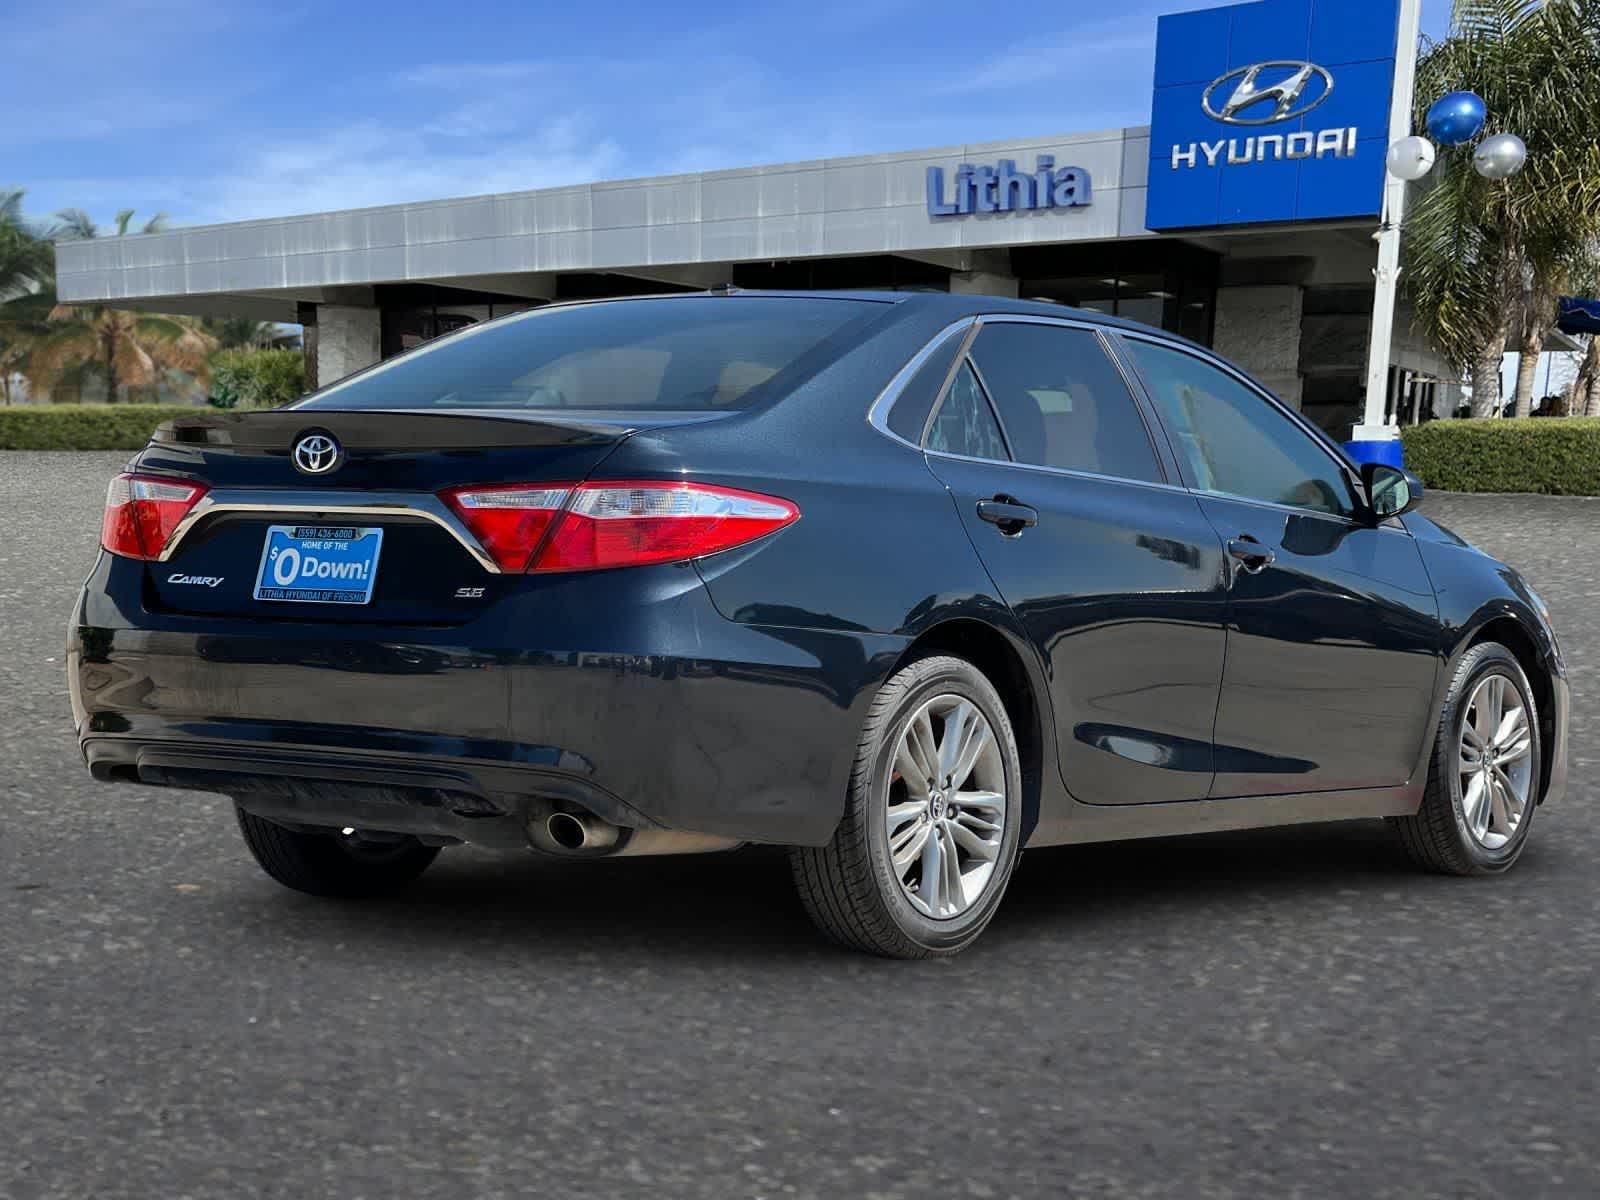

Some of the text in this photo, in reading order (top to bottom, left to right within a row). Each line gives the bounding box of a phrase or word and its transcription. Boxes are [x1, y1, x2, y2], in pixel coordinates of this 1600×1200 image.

[1171, 127, 1357, 169] HYUNDAI
[926, 155, 1092, 217] Lithia
[297, 528, 316, 538] (559)
[301, 541, 349, 551] HOME OF THE
[301, 557, 370, 579] Down!
[259, 588, 366, 602] LITHIA HYUNDAI OF FRESNO
[454, 587, 486, 598] SE
